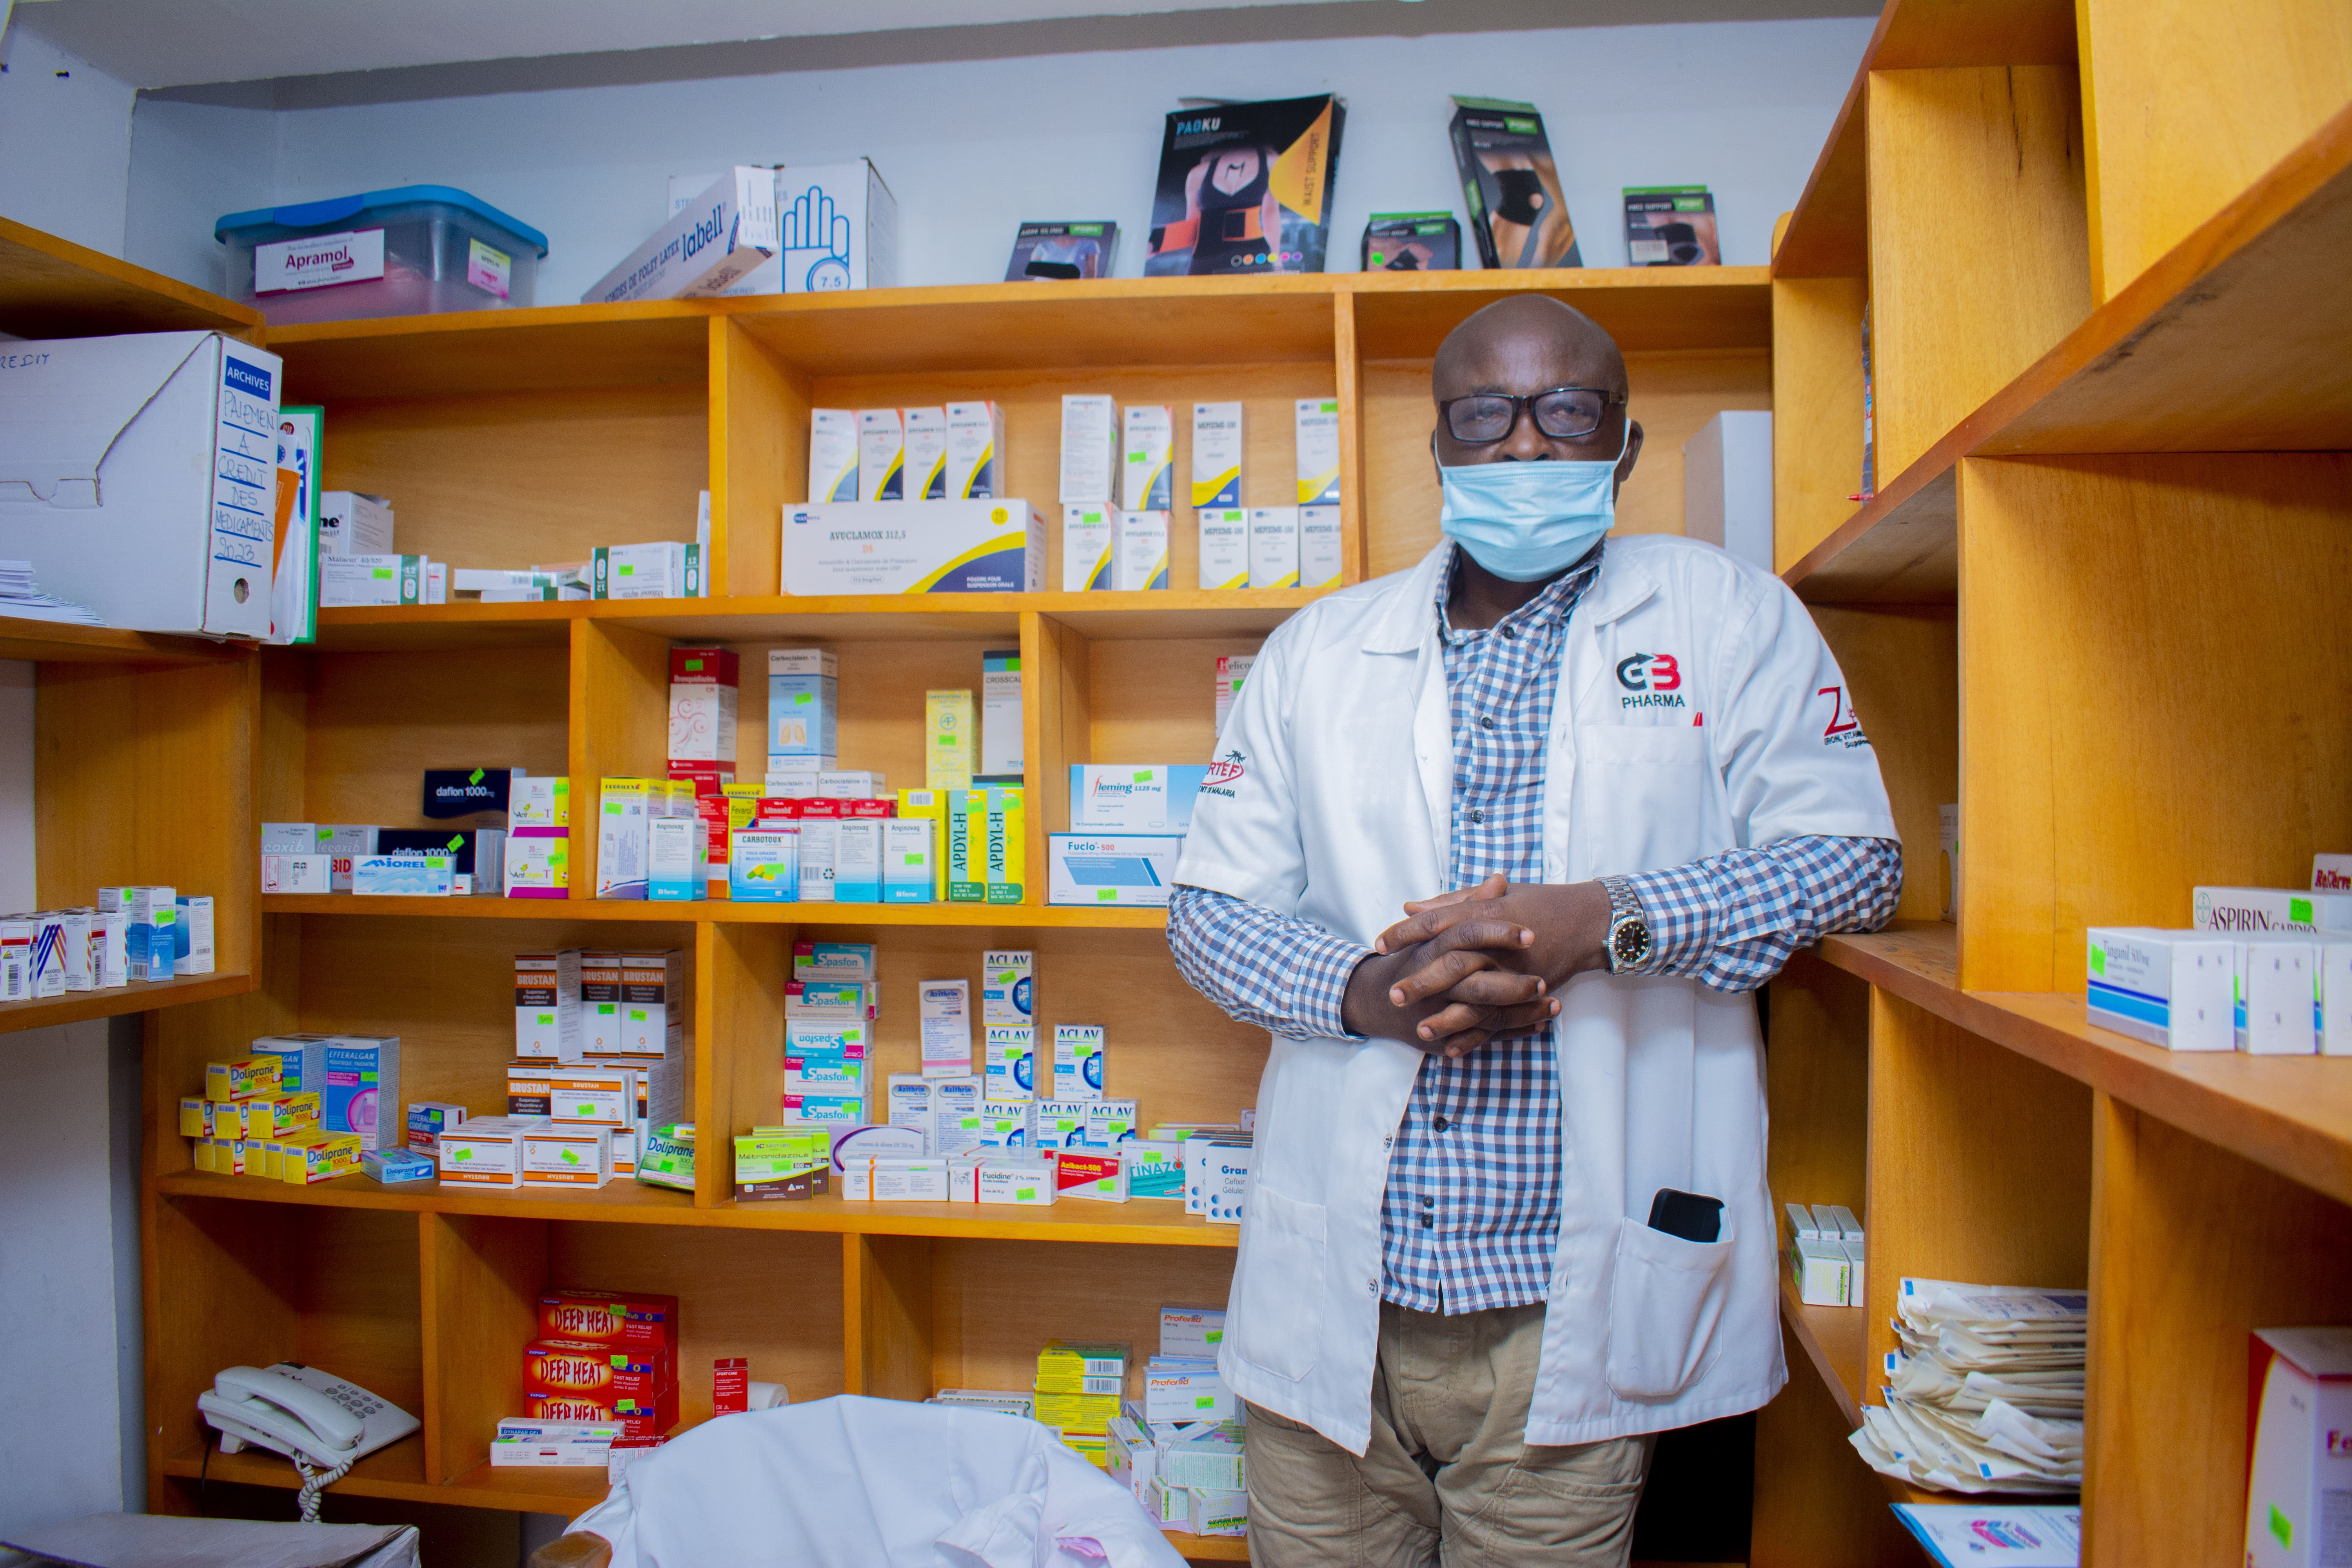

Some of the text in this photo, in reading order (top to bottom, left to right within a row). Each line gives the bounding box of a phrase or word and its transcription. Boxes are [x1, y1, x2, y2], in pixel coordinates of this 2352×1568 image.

[1177, 117, 1220, 136] PAOKU
[682, 205, 724, 262] labell
[286, 245, 347, 270] Apramol
[821, 276, 841, 287] 7.5
[227, 366, 270, 391] ARCHIVES
[224, 390, 279, 431] PAIEMENT
[239, 433, 250, 455] A
[218, 456, 267, 486] CREDIT
[232, 487, 257, 506] DES
[215, 510, 273, 542] MEDICAMENTS
[830, 530, 906, 540] AVUCLAMOX 312,5
[1622, 694, 1685, 708] PHARMA
[436, 786, 487, 797] daflon 1000
[1092, 775, 1132, 797] fleming
[1211, 787, 1235, 798] MALARIA
[953, 813, 966, 871] APDYL-H
[990, 812, 1003, 872] APDYL-H
[2209, 907, 2269, 932] ASPIRIN
[818, 953, 857, 967] Spasfon
[988, 955, 1028, 965] ACLAV
[517, 975, 555, 985] BRUSTAN
[624, 972, 663, 982] BRUSTAN
[799, 1034, 839, 1049] Spasfon
[990, 1030, 1029, 1041] ACLAV
[1059, 1029, 1098, 1040] ACLAV
[329, 1051, 374, 1060] EFFERALGAN
[230, 1065, 274, 1081] Doliprane
[808, 1067, 848, 1082] Spasfon
[510, 1082, 550, 1093] BRUSTAN
[898, 1084, 925, 1093] Azithrin
[944, 1085, 971, 1093] Azithrin
[274, 1103, 313, 1118] Doliprane
[808, 1105, 848, 1120] Spasfon
[984, 1105, 1021, 1116] ACLAV
[1041, 1105, 1081, 1115] ACLAV
[1091, 1107, 1132, 1117] ACLAV
[308, 1146, 353, 1163] Doliprane
[647, 1137, 695, 1158] Doliprane
[1061, 1161, 1102, 1172] Azibact-500
[555, 1307, 613, 1334] DEEP HEAT
[1164, 1314, 1202, 1323] Profenid
[541, 1357, 605, 1386] DEEP HEAT
[1151, 1377, 1189, 1386] Profenid
[575, 1403, 605, 1421] HEAT
